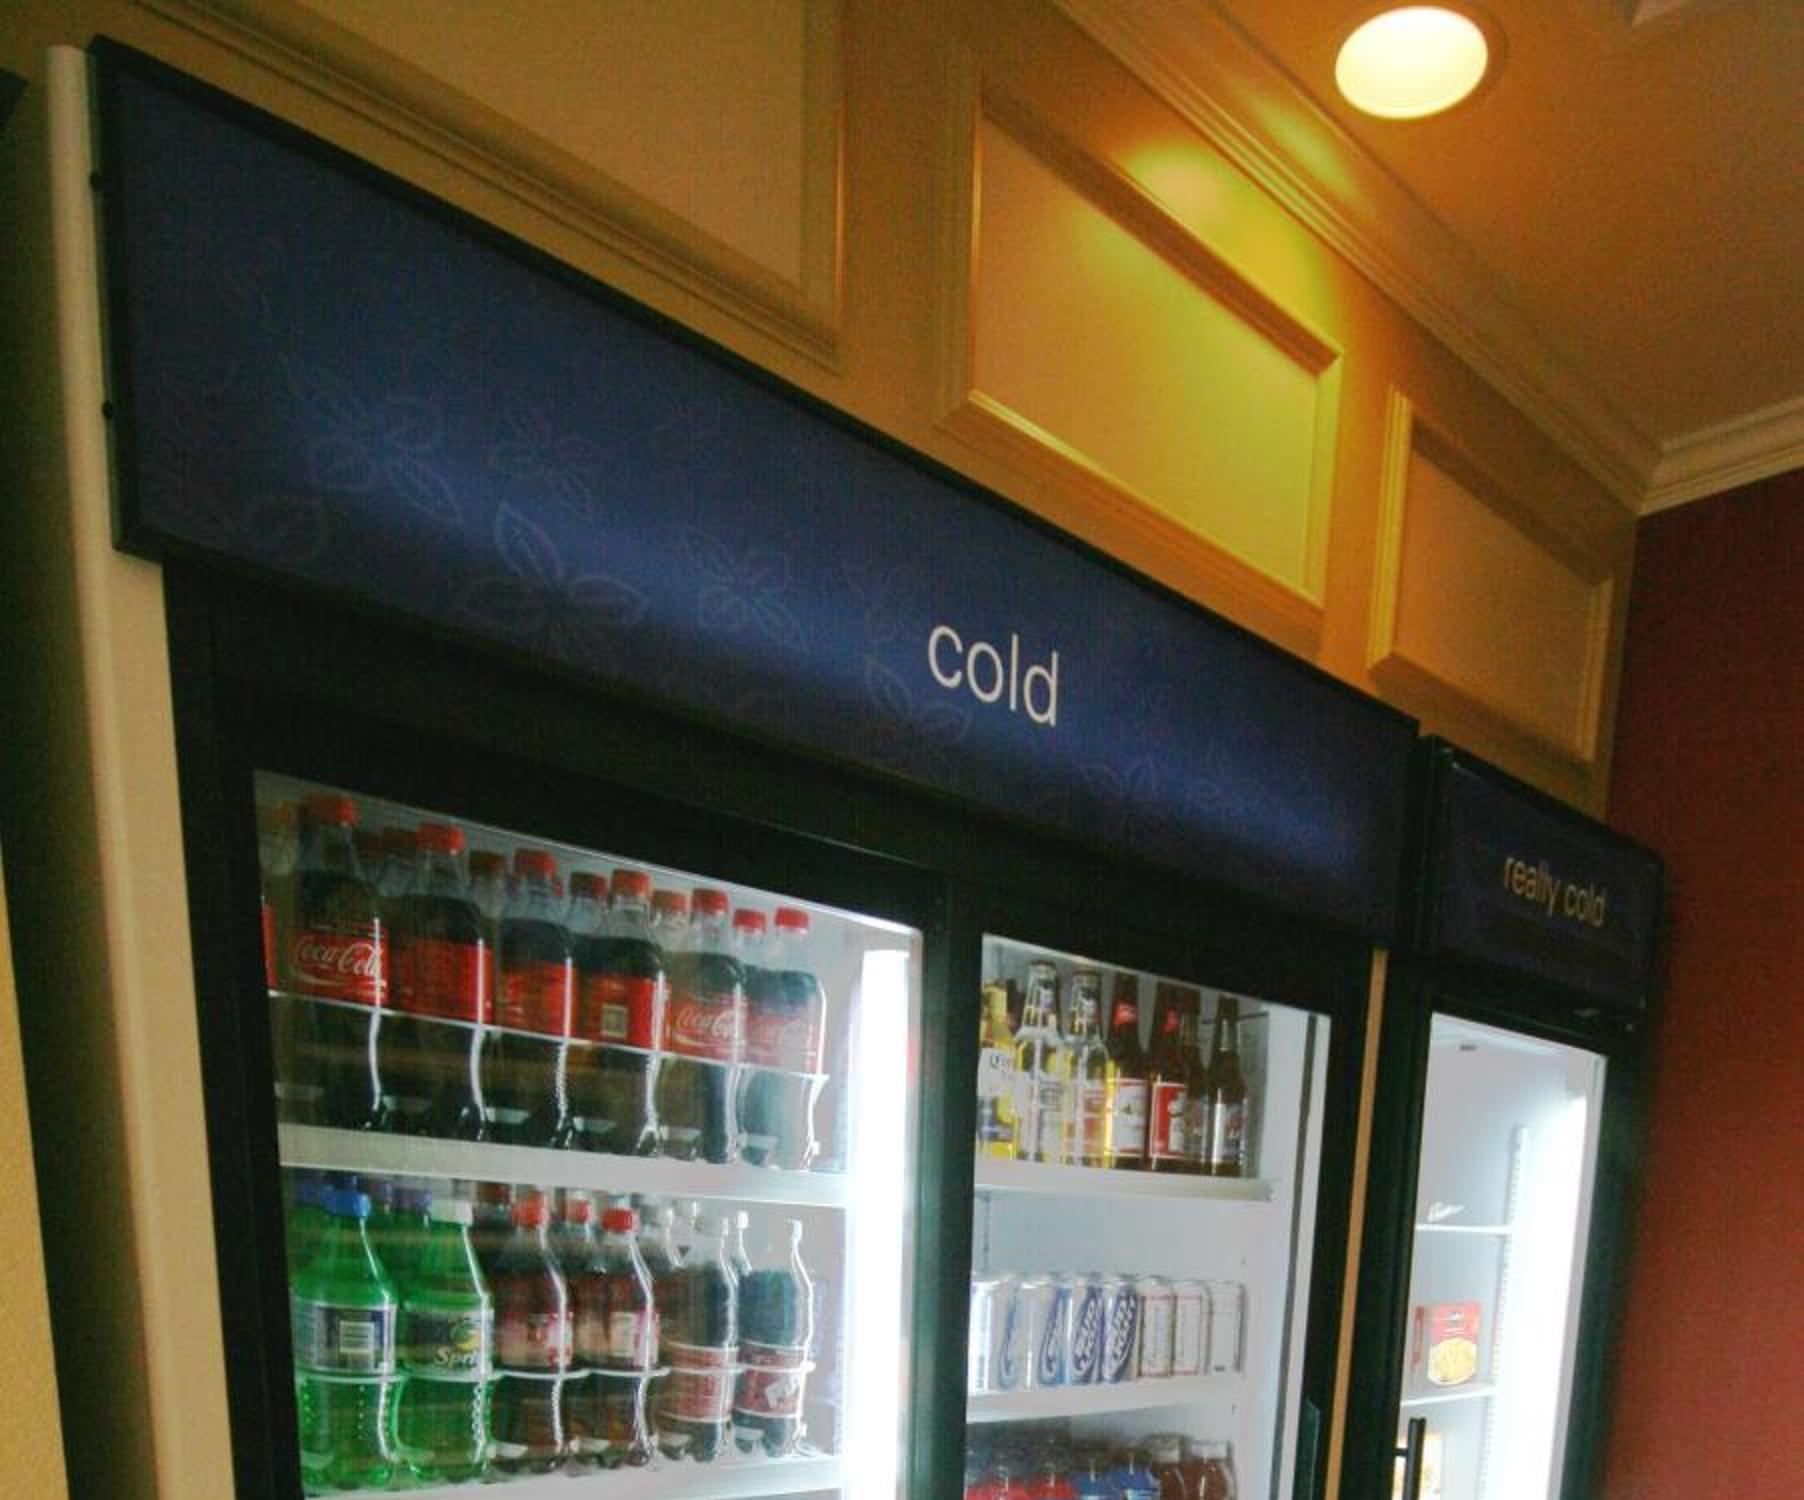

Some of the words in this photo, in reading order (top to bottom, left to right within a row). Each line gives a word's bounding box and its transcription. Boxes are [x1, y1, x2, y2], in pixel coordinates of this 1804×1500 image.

[928, 624, 1060, 728] cold
[1503, 856, 1562, 918] really
[1564, 881, 1608, 928] cold
